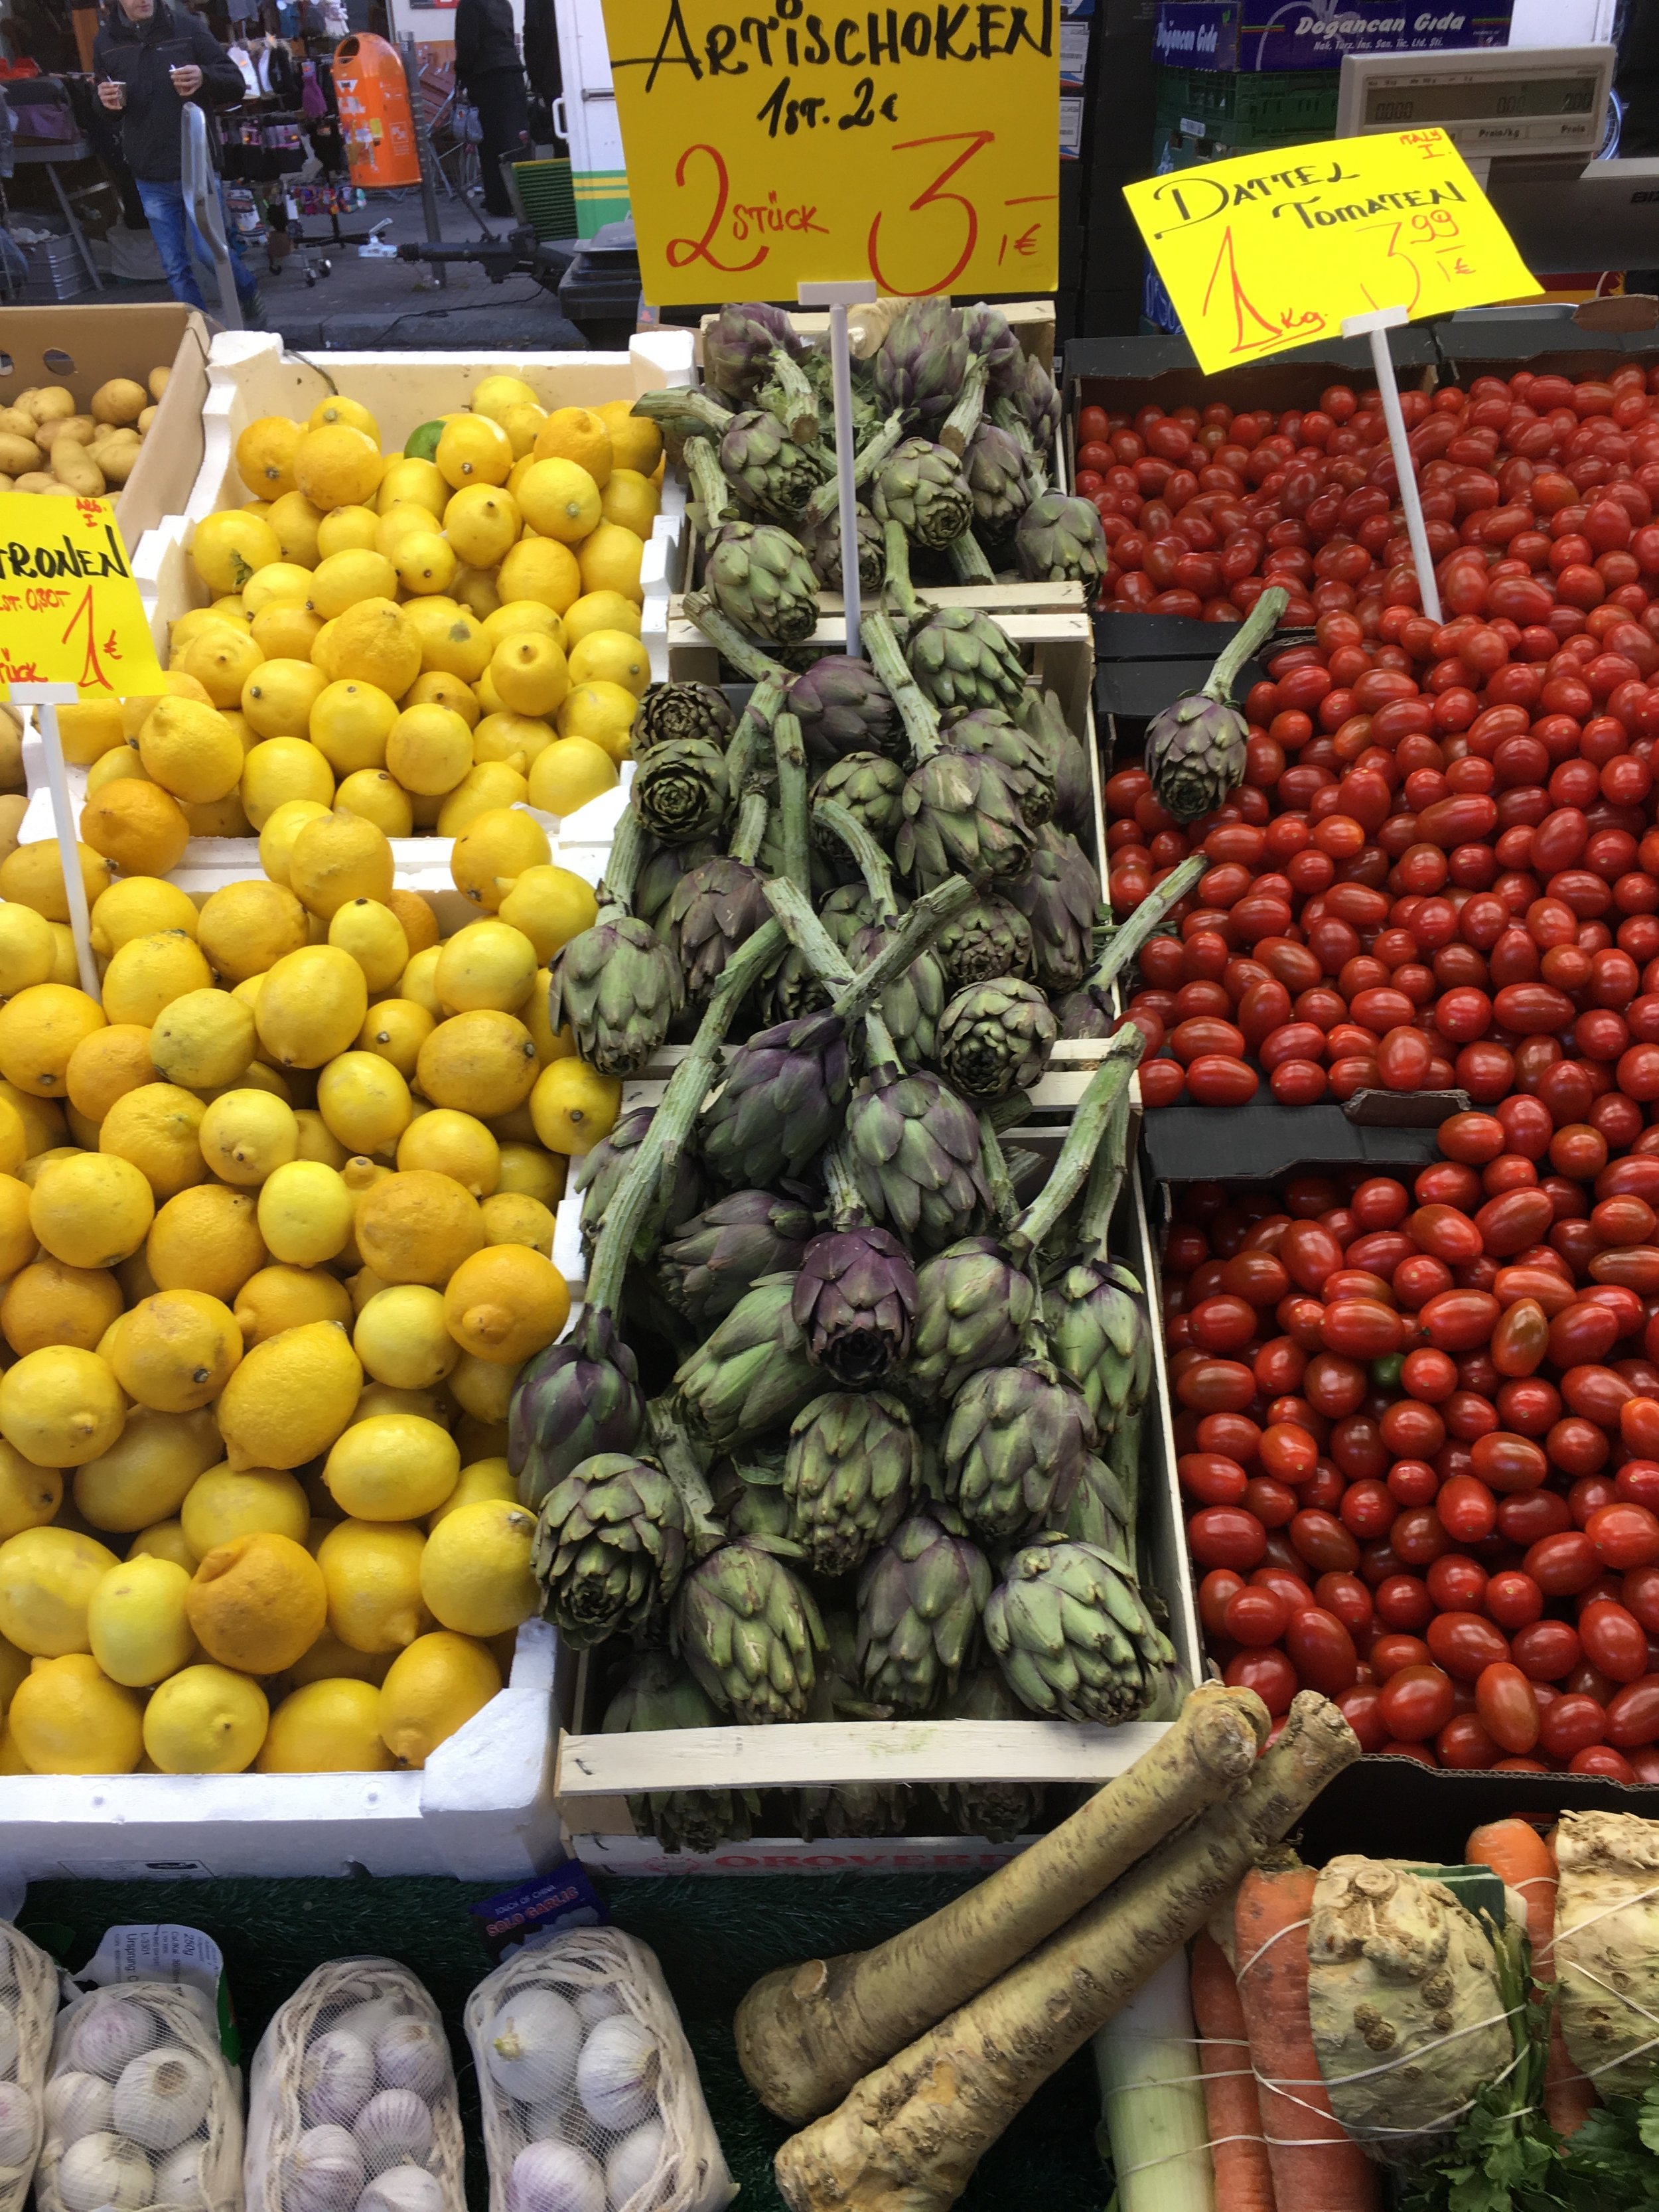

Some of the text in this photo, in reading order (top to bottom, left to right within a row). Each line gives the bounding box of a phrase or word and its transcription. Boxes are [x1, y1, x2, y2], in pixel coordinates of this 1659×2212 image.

[1295, 13, 1406, 40] Doğancan
[1272, 180, 1468, 230] TOMATEN
[486, 1886, 579, 1937] SOLO GARLIC
